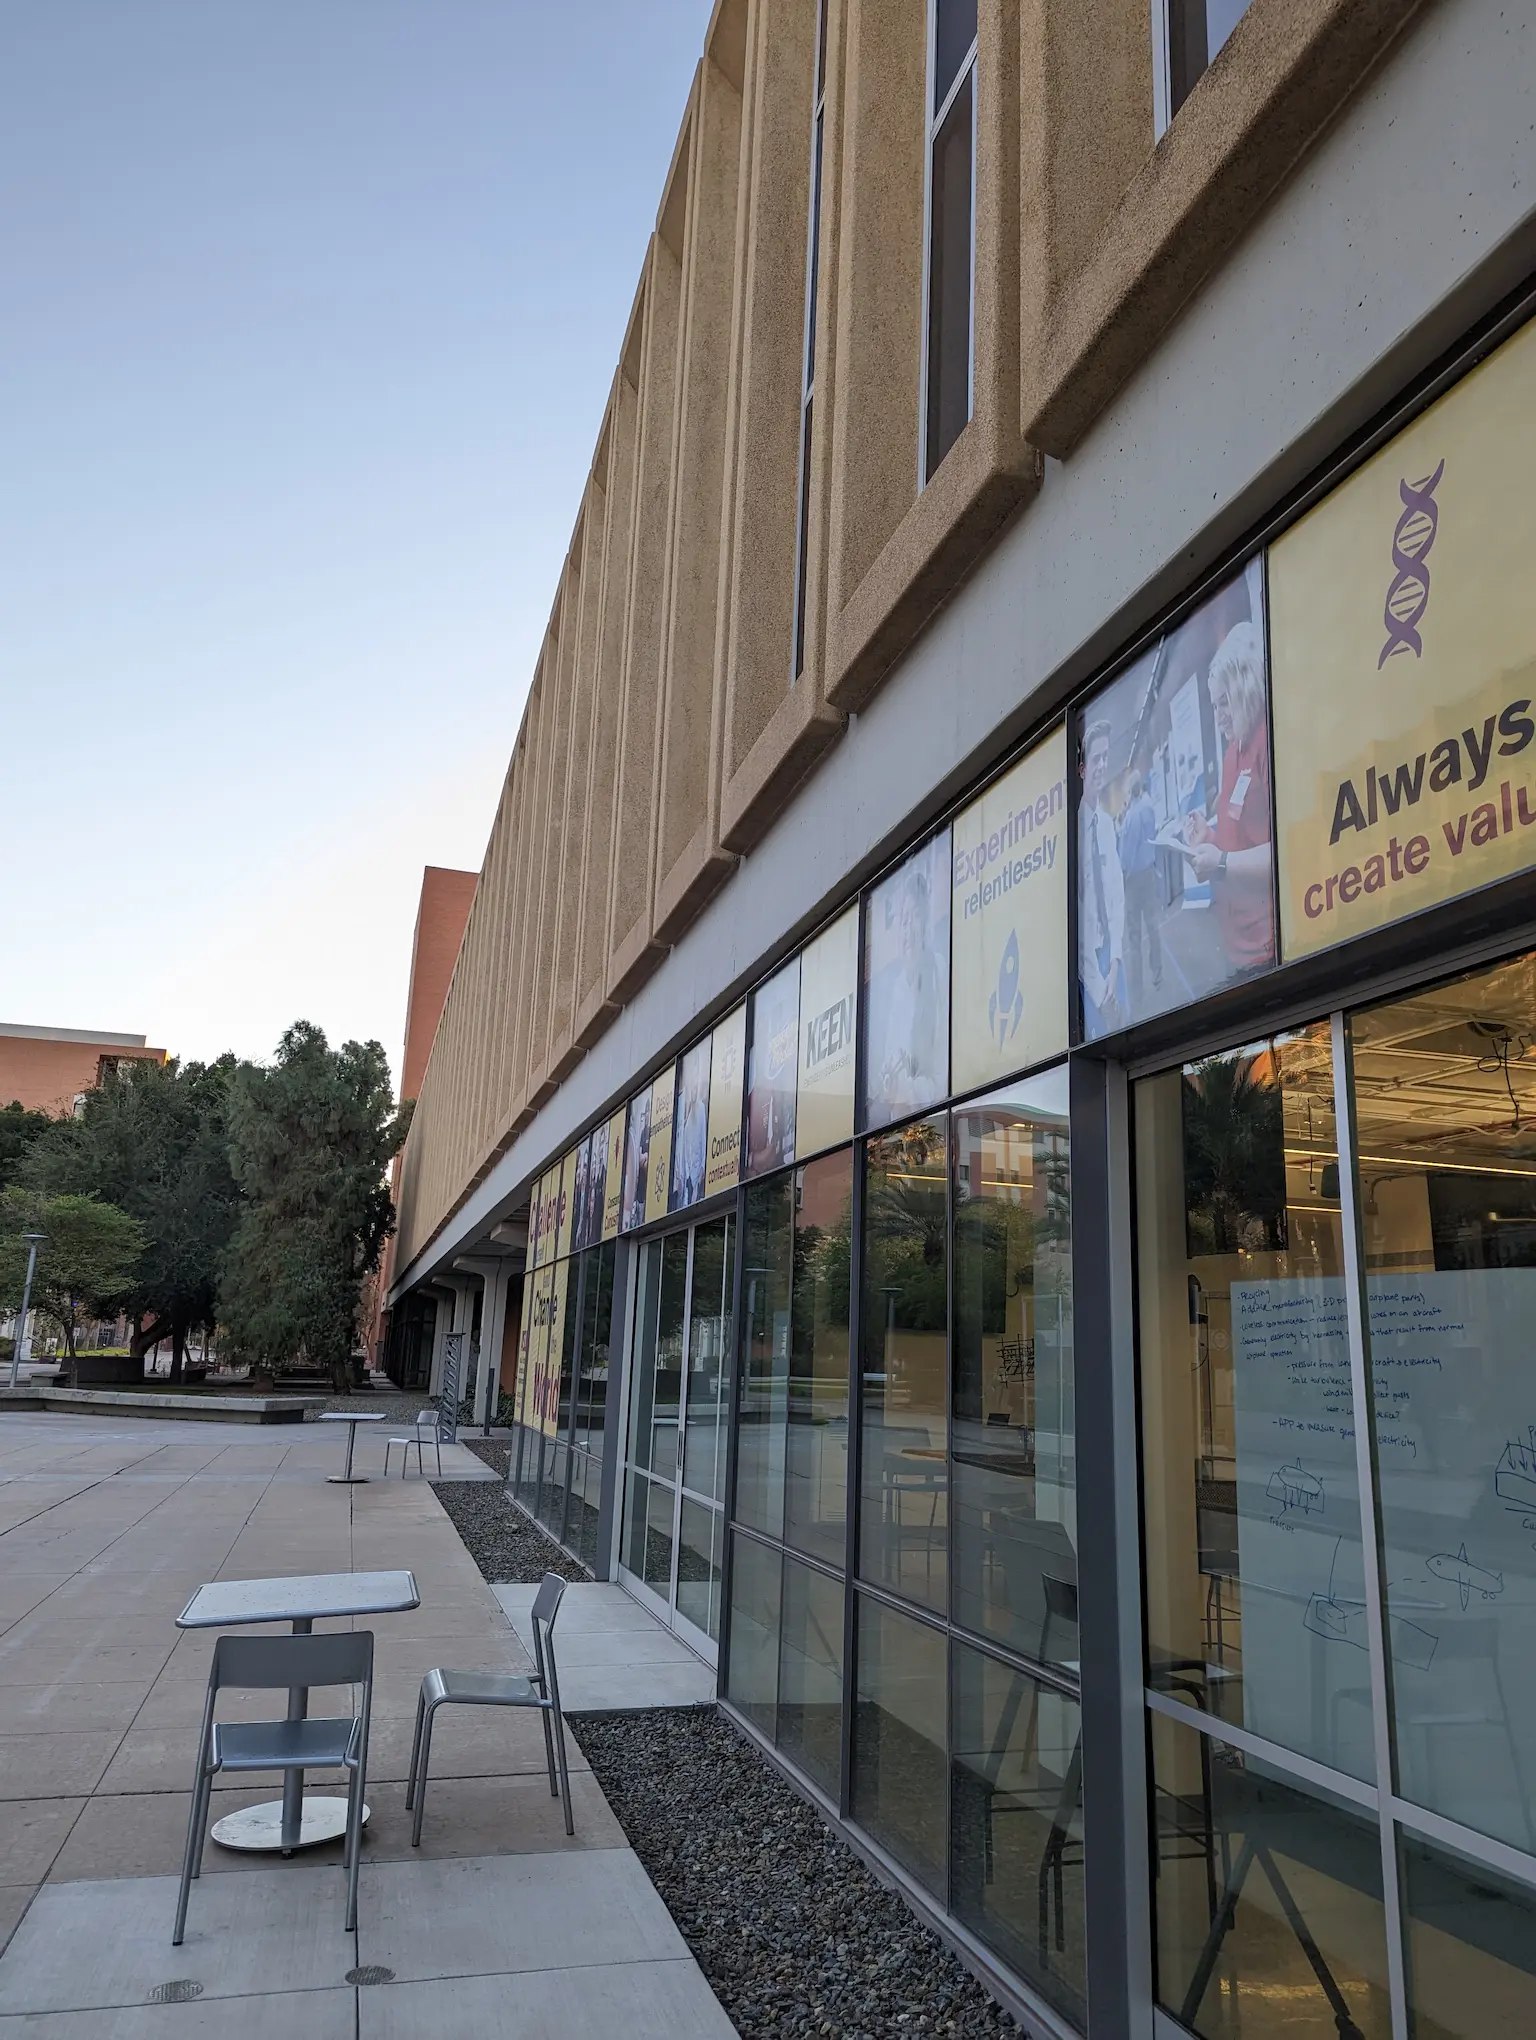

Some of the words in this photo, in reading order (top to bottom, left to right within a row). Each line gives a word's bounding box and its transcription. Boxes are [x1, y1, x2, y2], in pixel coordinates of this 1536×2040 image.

[1328, 698, 1535, 847] Always
[964, 834, 1058, 919] relentlessly
[1304, 837, 1431, 919] create
[806, 992, 853, 1070] KEEN
[711, 1124, 740, 1159] Connect
[530, 1190, 566, 1243] Callene
[534, 1289, 558, 1327] Chane
[1240, 1288, 1271, 1304] Recycling
[1398, 1309, 1408, 1317] an
[1299, 1329, 1310, 1344] by
[1418, 1324, 1436, 1333] from
[1291, 1360, 1316, 1372] pressure
[1319, 1358, 1334, 1368] from
[1295, 1421, 1305, 1431] to
[1378, 1434, 1417, 1459] electricity
